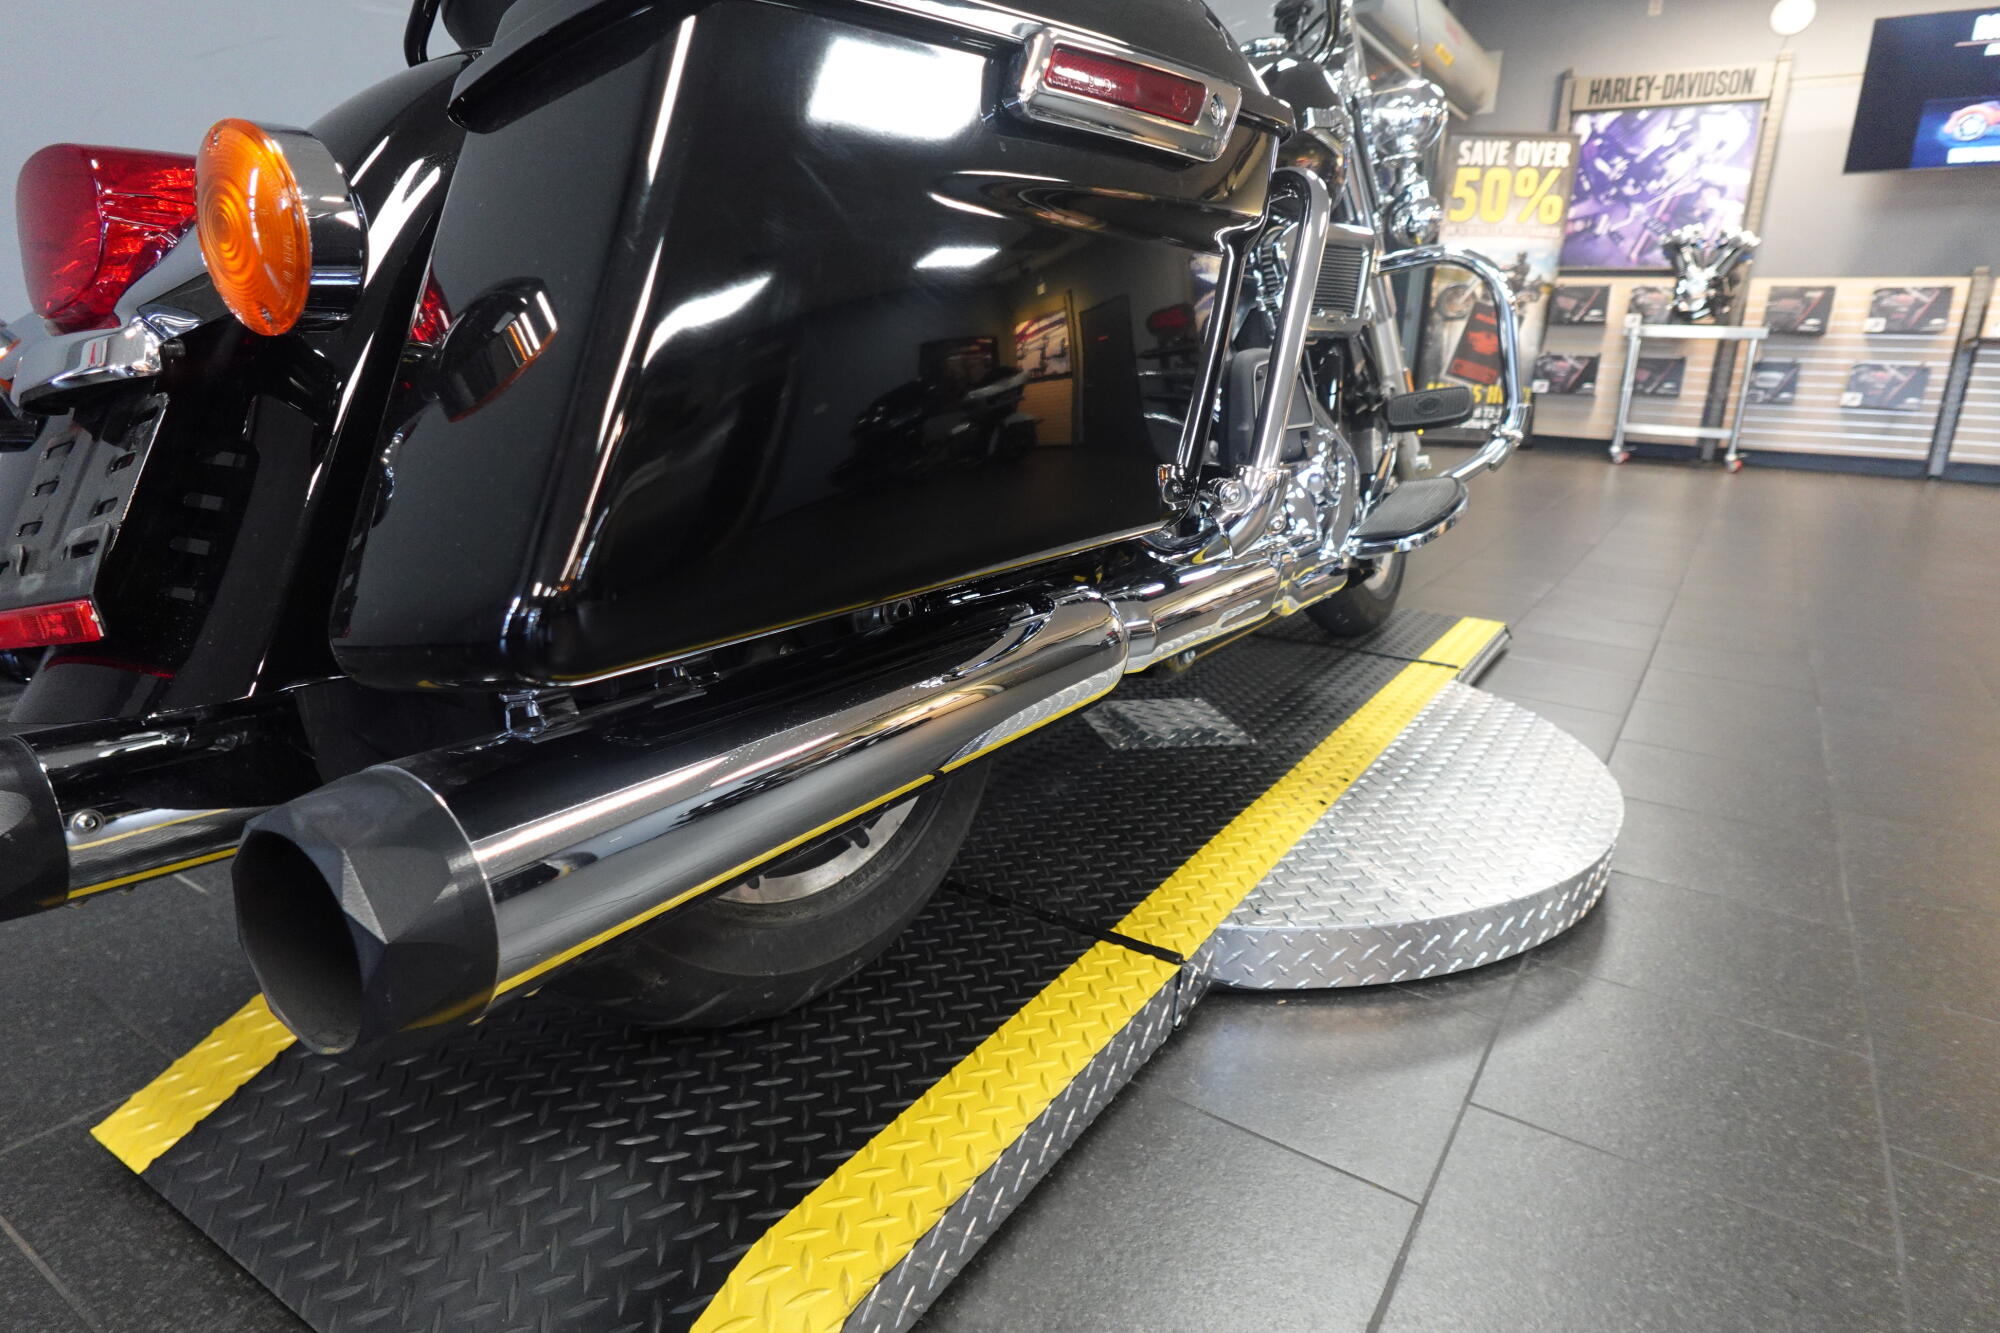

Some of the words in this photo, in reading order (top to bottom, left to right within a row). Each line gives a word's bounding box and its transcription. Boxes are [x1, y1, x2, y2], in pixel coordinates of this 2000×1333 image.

[1588, 68, 1756, 105] HARLEY-DAVIDSON
[1457, 140, 1511, 167] SAVE
[1514, 140, 1572, 168] OVER
[1448, 166, 1564, 225] 50%
